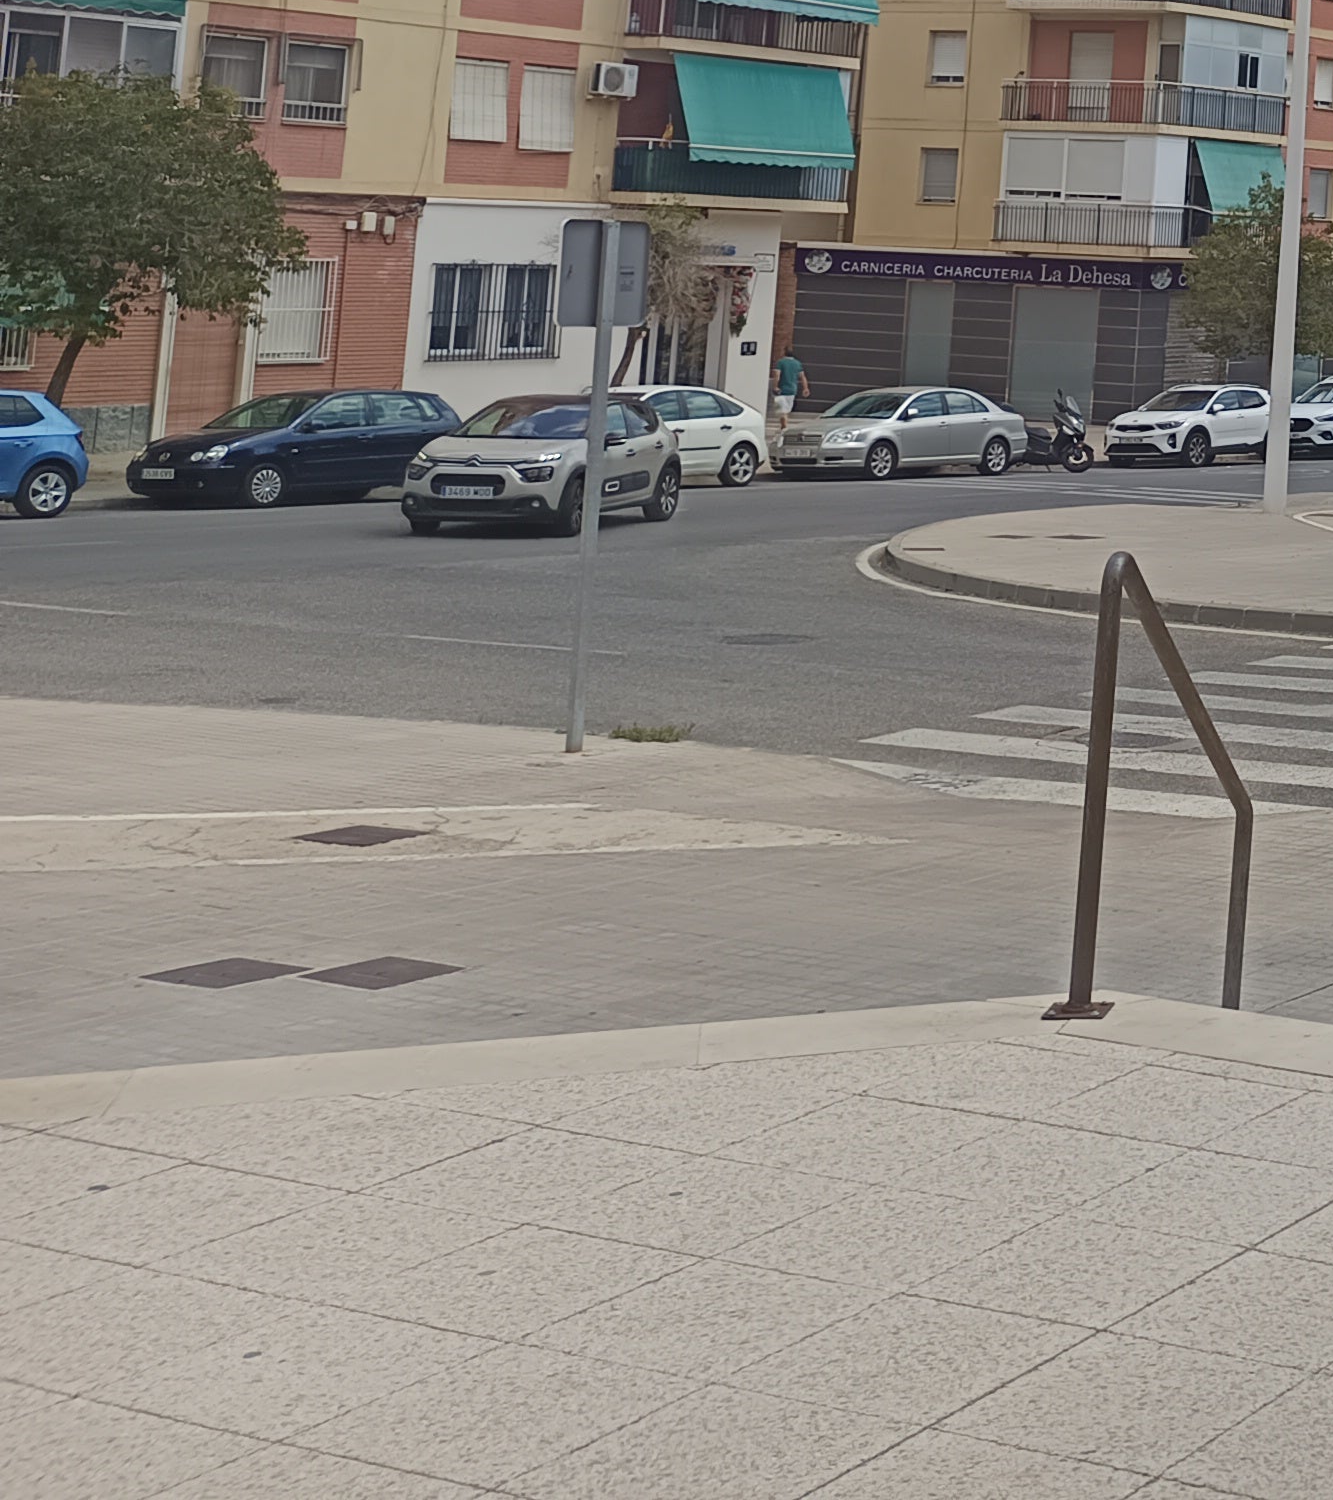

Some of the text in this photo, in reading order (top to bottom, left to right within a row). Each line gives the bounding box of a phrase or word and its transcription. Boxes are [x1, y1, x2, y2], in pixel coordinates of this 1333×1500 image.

[841, 261, 1132, 286] CARNICERIA CHARCUTERIA La Dehesa
